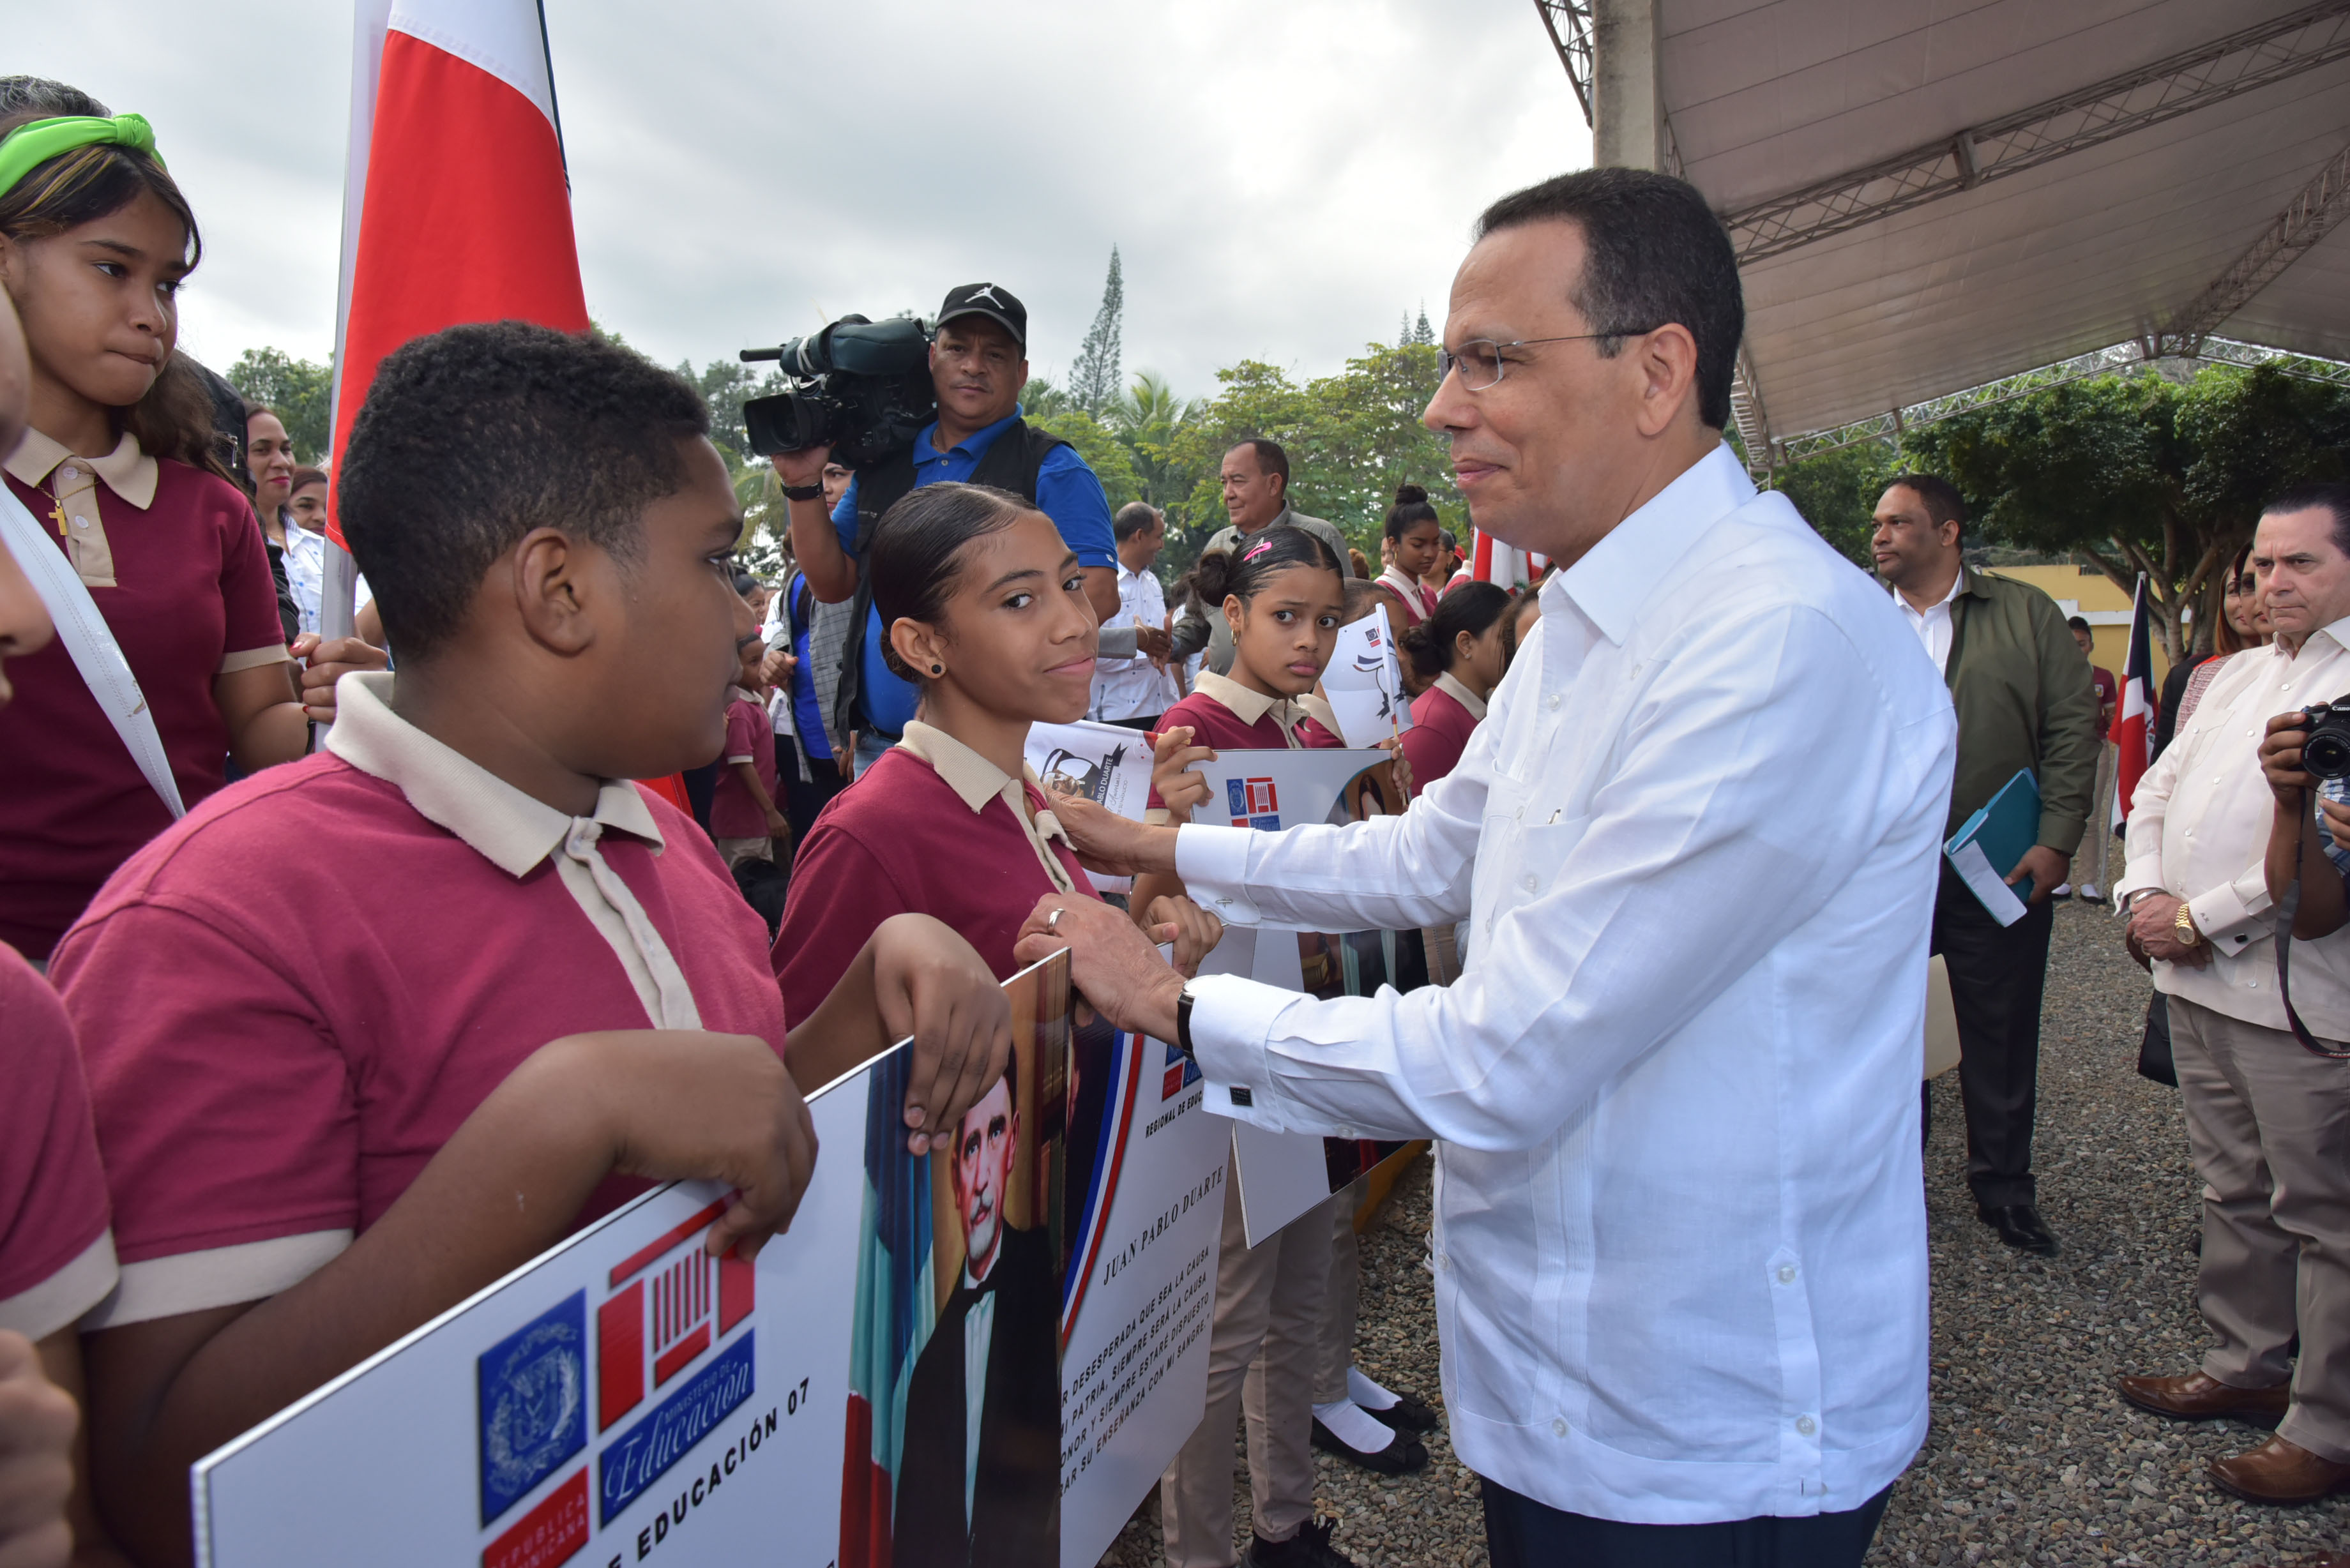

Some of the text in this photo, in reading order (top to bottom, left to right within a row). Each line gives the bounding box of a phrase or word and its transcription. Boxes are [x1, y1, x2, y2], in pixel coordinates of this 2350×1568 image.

[1096, 757, 1113, 804] ABLO DUARTE
[1146, 1108, 1176, 1138] REGIONAL
[1178, 1101, 1186, 1117] DE
[1103, 1166, 1223, 1286] JUAN PABLO DUARTE
[1061, 1292, 1209, 1468] ONOR Y SIEMPRE ESTARÉ DISPUESTO
[1072, 1318, 1136, 1397] DESESPERADA
[1139, 1297, 1155, 1324] QUE
[1158, 1281, 1172, 1306] SEA
[1175, 1269, 1184, 1288] LA
[1186, 1245, 1209, 1276] CAUSA
[1072, 1378, 1108, 1426] PATRIA,
[1112, 1332, 1148, 1381] SIEMPRE
[1150, 1306, 1170, 1339] SERÁ
[1172, 1297, 1181, 1315] LA
[1184, 1271, 1206, 1303] CAUSA
[604, 1361, 750, 1508] Educación
[665, 1371, 718, 1425] MINISTERIO
[1080, 1447, 1093, 1472] SU
[1096, 1387, 1145, 1454] ENSEÑANZA
[1149, 1364, 1164, 1391] CON
[1167, 1352, 1175, 1371] MI
[638, 1406, 777, 1562] EDUCACIÓN
[787, 1376, 809, 1416] 07
